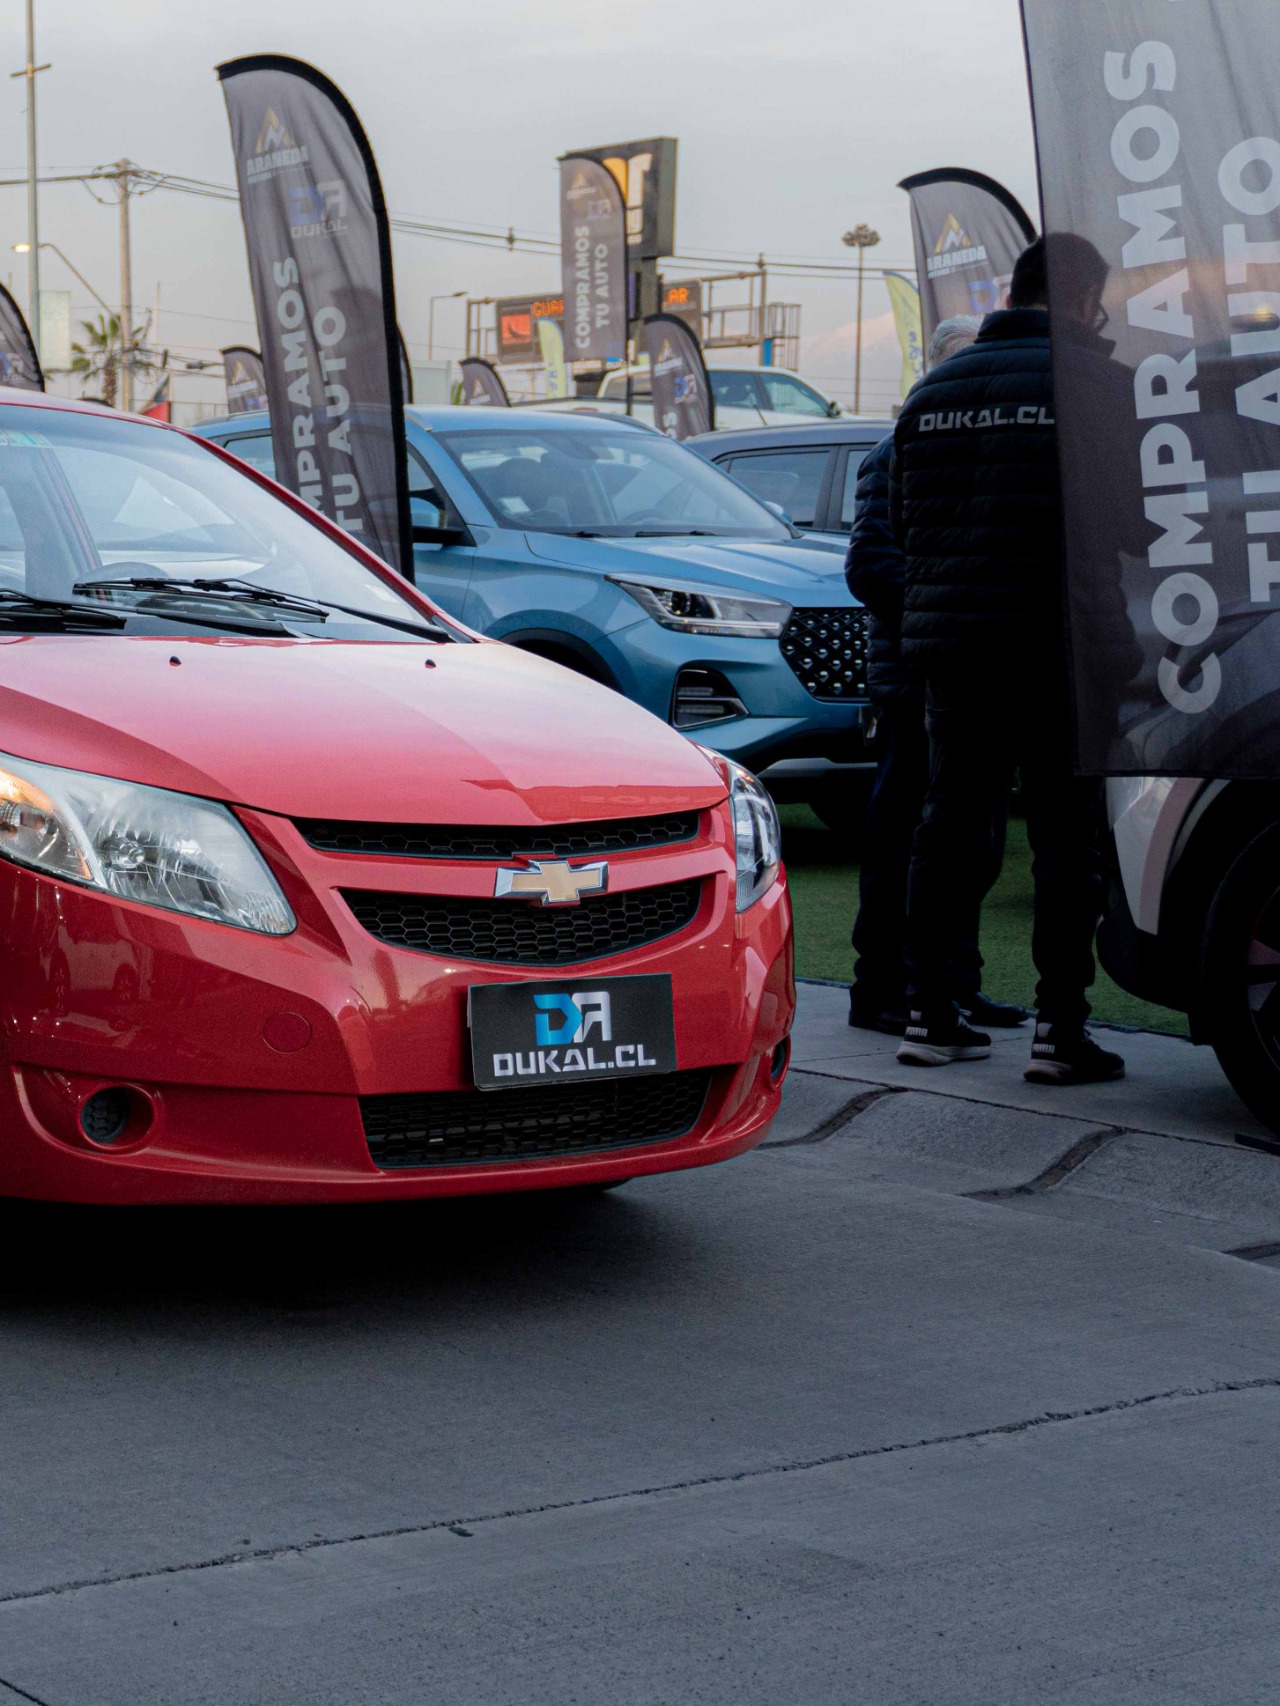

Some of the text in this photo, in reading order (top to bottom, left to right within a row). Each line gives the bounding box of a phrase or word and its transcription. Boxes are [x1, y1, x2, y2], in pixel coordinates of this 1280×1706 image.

[575, 226, 591, 349] COMPRAMOS
[594, 243, 610, 329] TU AUTO
[926, 245, 989, 273] ARANEDA
[273, 256, 326, 515] MPRAMOS
[313, 304, 365, 533] TU AUTO
[918, 405, 1056, 433] DUKAL.CL
[1104, 40, 1221, 714] COMPRAMOS
[493, 1044, 657, 1078] DUKAL.CL
